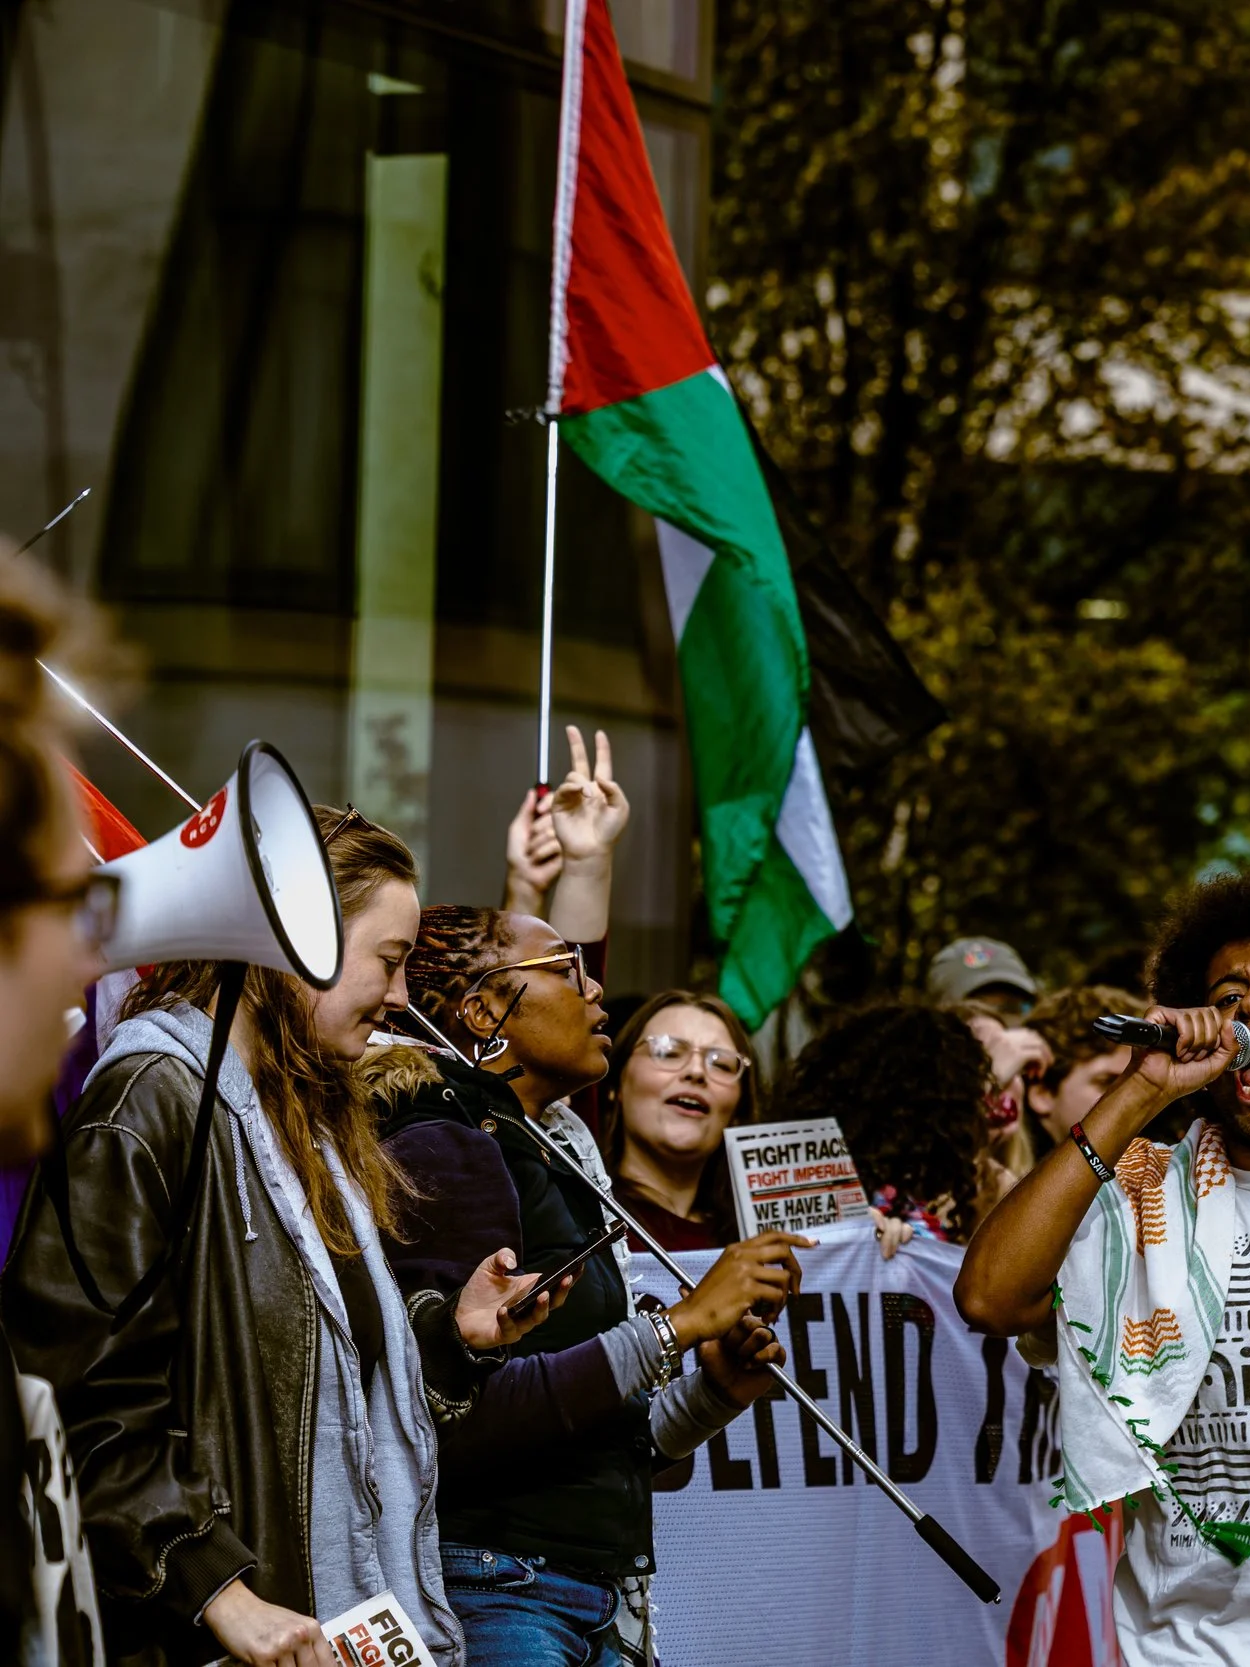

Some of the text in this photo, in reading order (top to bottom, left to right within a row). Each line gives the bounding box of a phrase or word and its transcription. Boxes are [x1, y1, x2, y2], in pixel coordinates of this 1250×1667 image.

[741, 1142, 802, 1169] FIGHT
[1090, 1156, 1110, 1180] SAVE
[747, 1169, 789, 1189] FIGHT
[753, 1201, 779, 1220] WE
[785, 1195, 825, 1216] HAVE
[827, 1194, 837, 1213] A
